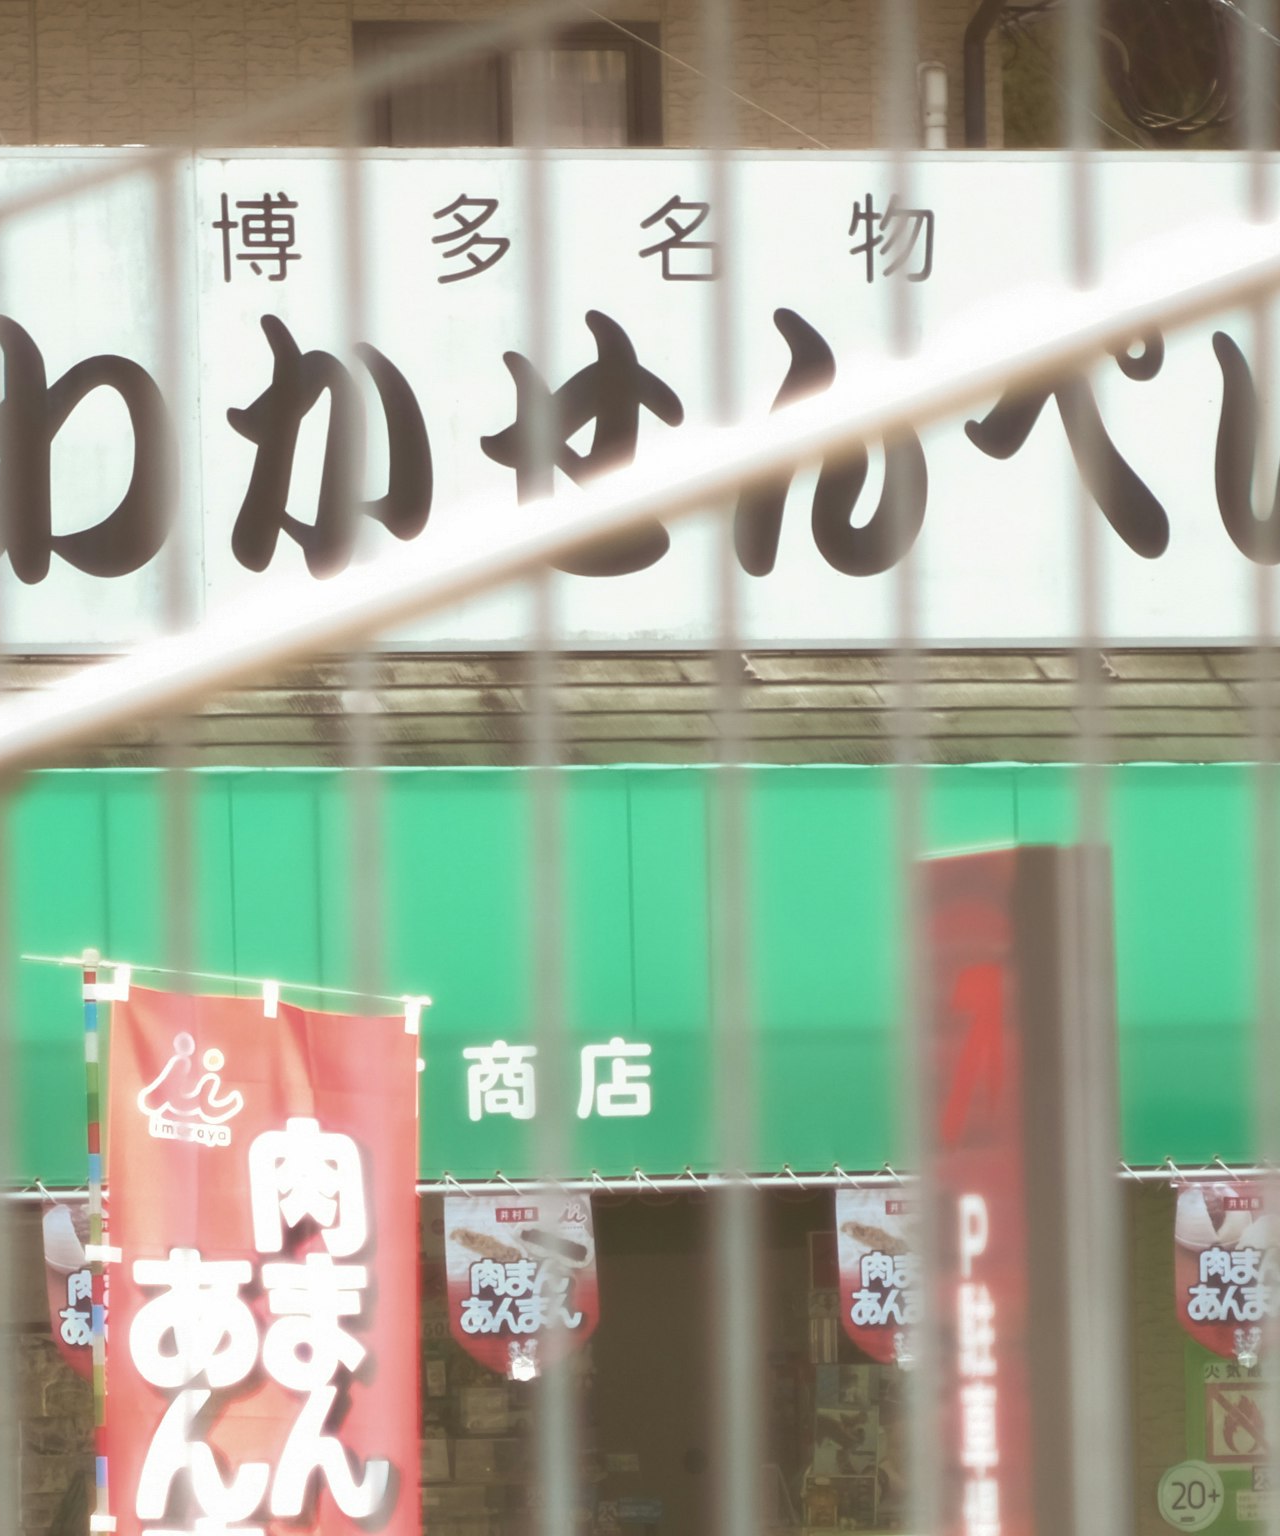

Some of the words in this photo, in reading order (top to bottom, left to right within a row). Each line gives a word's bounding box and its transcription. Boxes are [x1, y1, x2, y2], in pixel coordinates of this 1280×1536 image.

[212, 191, 935, 284] 博多名物
[155, 1123, 227, 1141] imaya
[470, 1258, 570, 1297] 肉まん
[861, 1251, 925, 1289] 肉ま
[248, 1117, 390, 1518] 肉まん
[460, 1293, 583, 1335] あんまん
[850, 1289, 925, 1327] あんま
[1171, 1481, 1222, 1511] 20+
